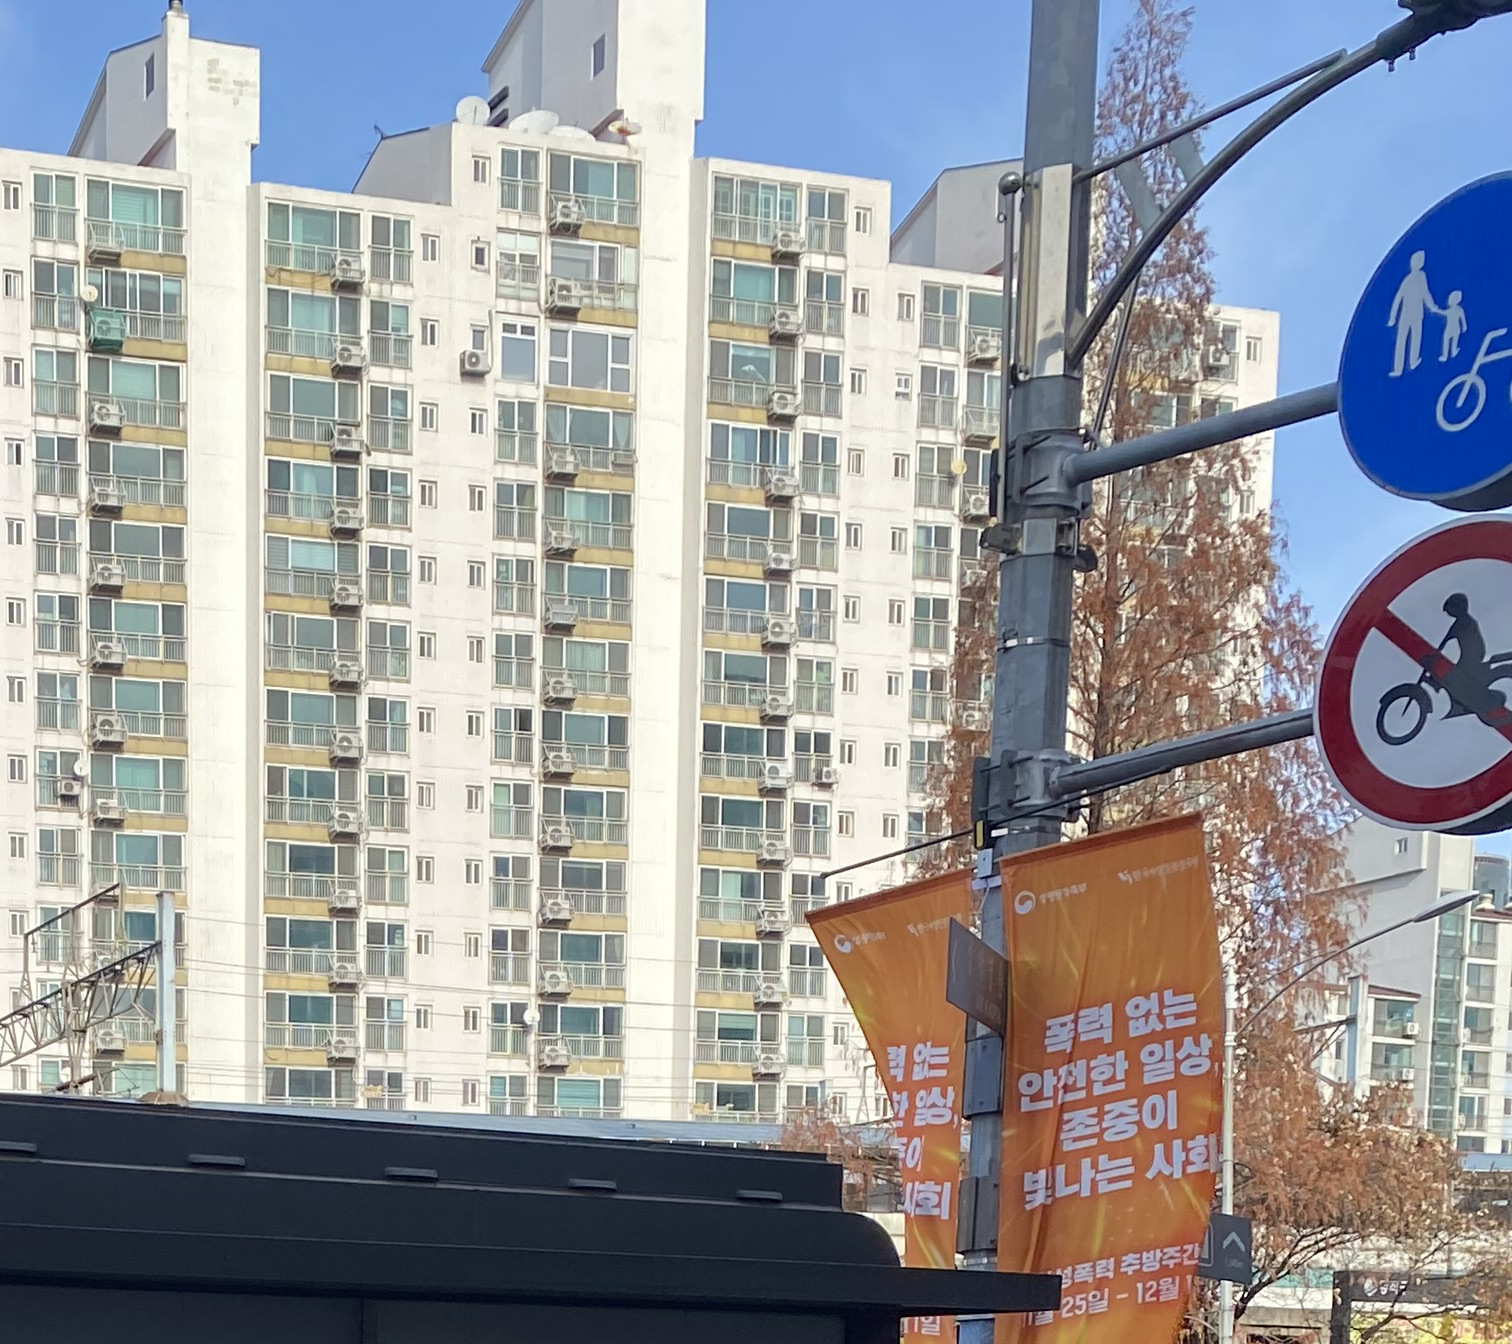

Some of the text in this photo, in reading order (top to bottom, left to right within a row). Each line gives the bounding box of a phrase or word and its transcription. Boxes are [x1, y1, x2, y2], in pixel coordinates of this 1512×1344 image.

[1044, 988, 1198, 1054] 폭력 없는
[886, 1041, 950, 1082] 력 없는
[1018, 1050, 1129, 1112] 안전한
[1060, 1090, 1178, 1152] 존중이
[1023, 1132, 1218, 1211] 빛나는 사회
[1047, 1242, 1201, 1290] 성폭력 추방주간
[1061, 1287, 1109, 1319] 25일
[1136, 1276, 1180, 1304] 12월
